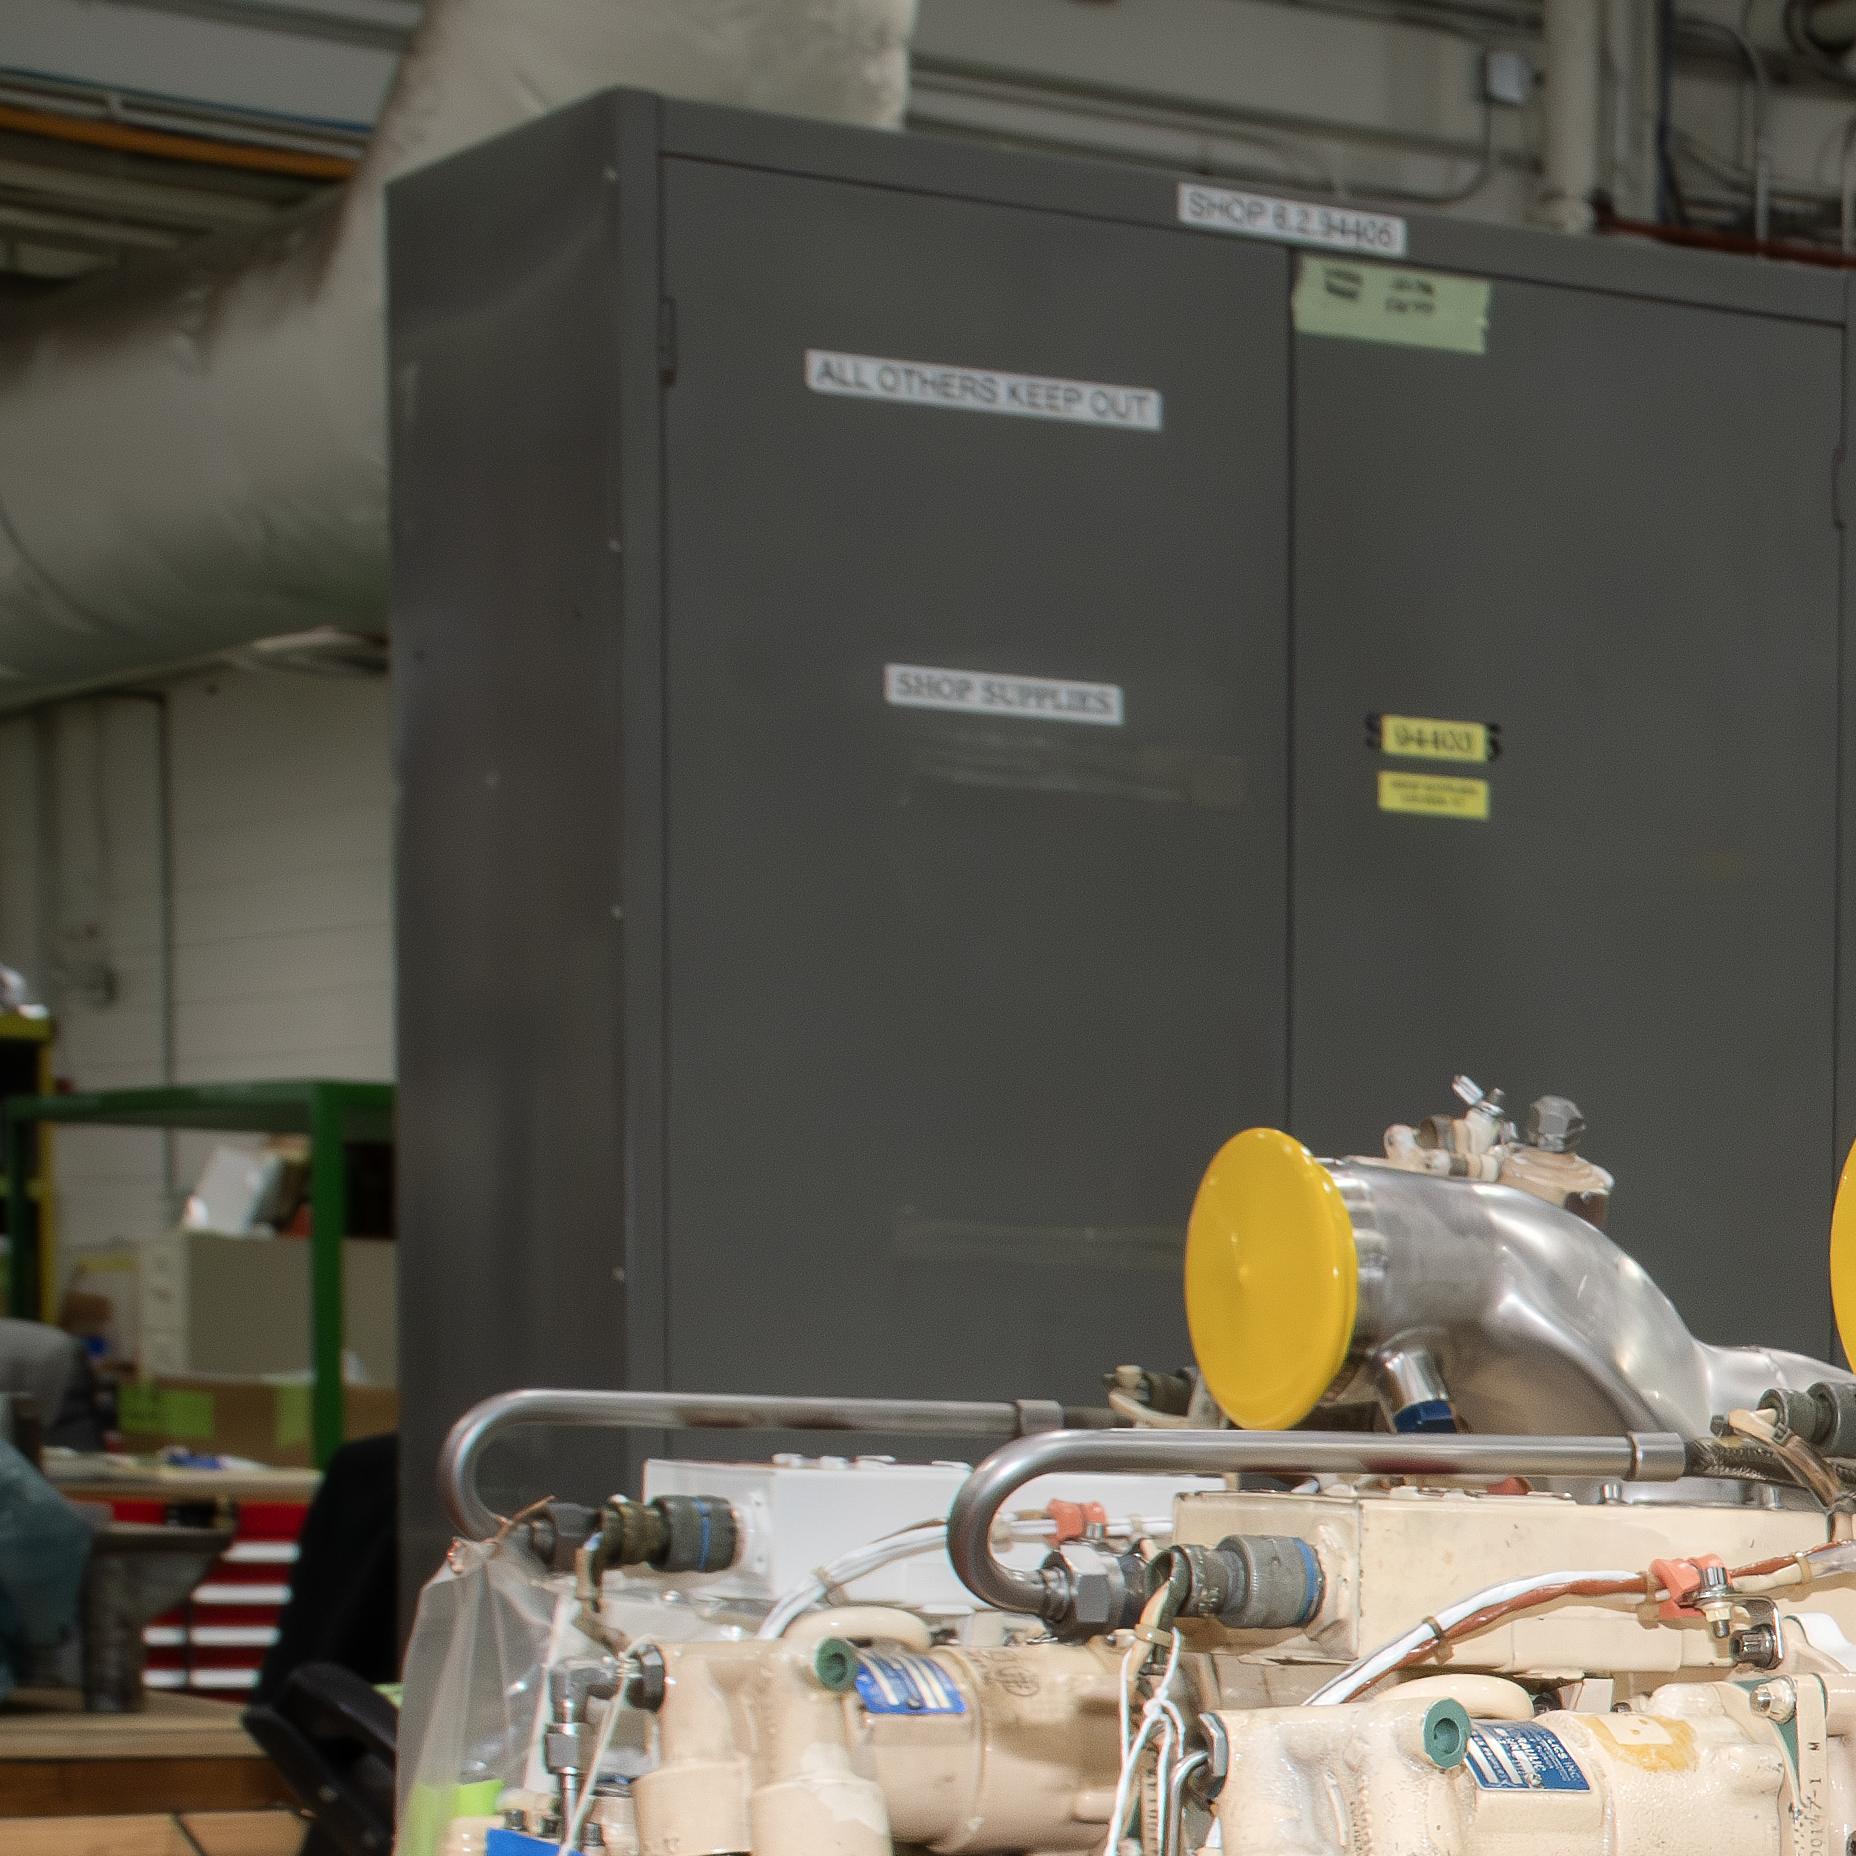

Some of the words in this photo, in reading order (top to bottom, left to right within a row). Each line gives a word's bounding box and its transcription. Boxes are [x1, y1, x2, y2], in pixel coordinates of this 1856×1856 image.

[815, 358, 872, 390] ALL
[878, 363, 997, 405] OTHERS
[1005, 381, 1083, 412] KEEP
[1088, 388, 1149, 420] OUT
[895, 671, 974, 698] SHOP
